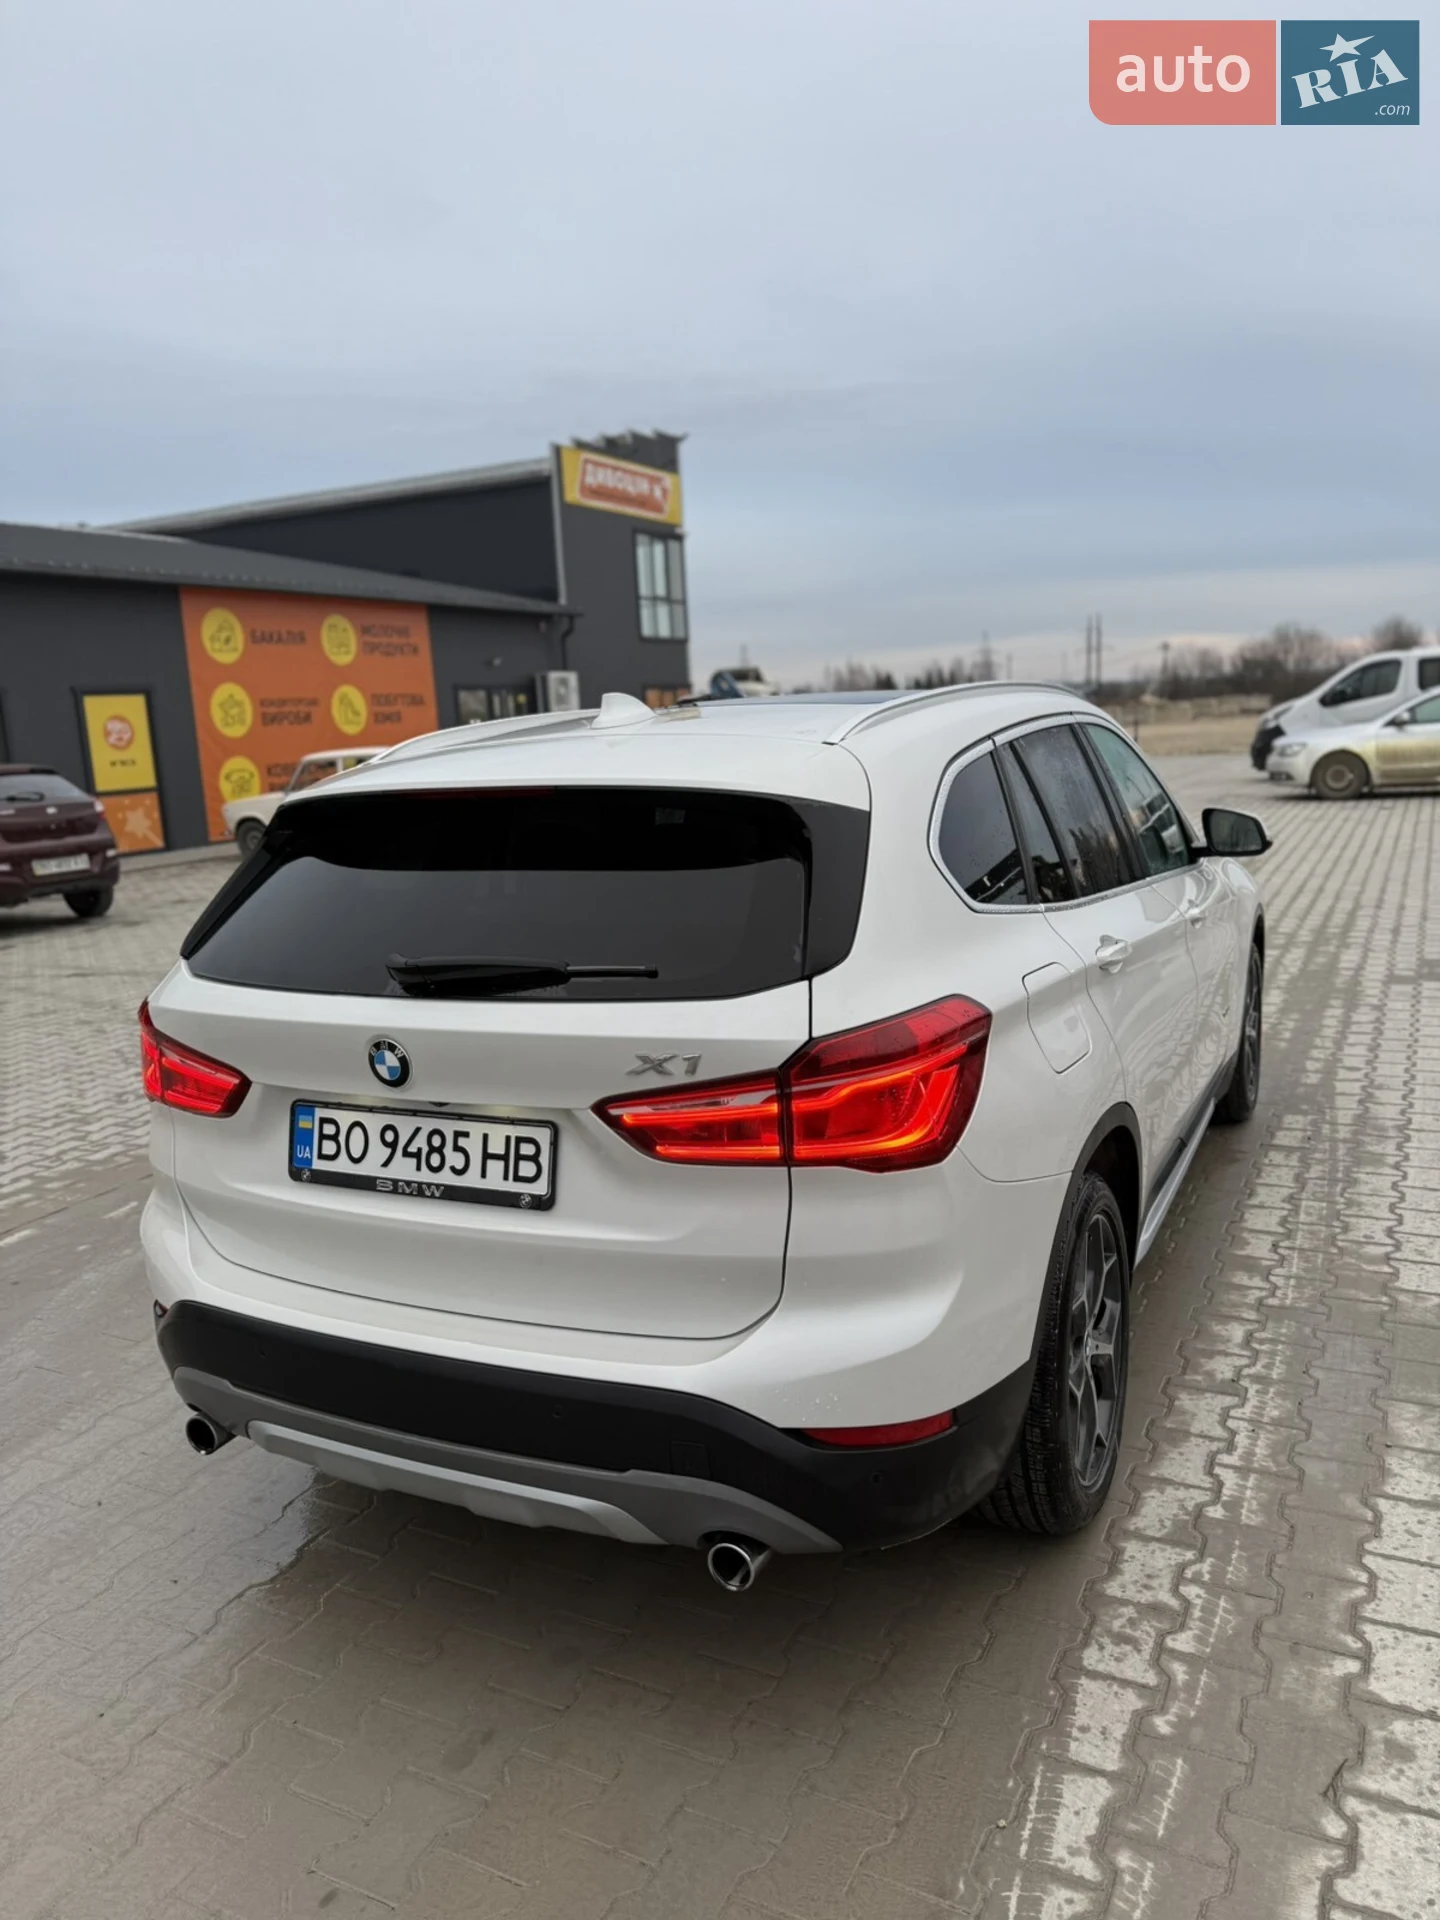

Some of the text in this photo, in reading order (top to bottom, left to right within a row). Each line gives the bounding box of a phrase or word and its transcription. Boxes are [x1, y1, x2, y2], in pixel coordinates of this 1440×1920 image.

[625, 1052, 702, 1076] X1
[296, 1145, 311, 1159] UA
[317, 1116, 543, 1184] BO 9485 HB
[376, 1179, 445, 1198] BMW
